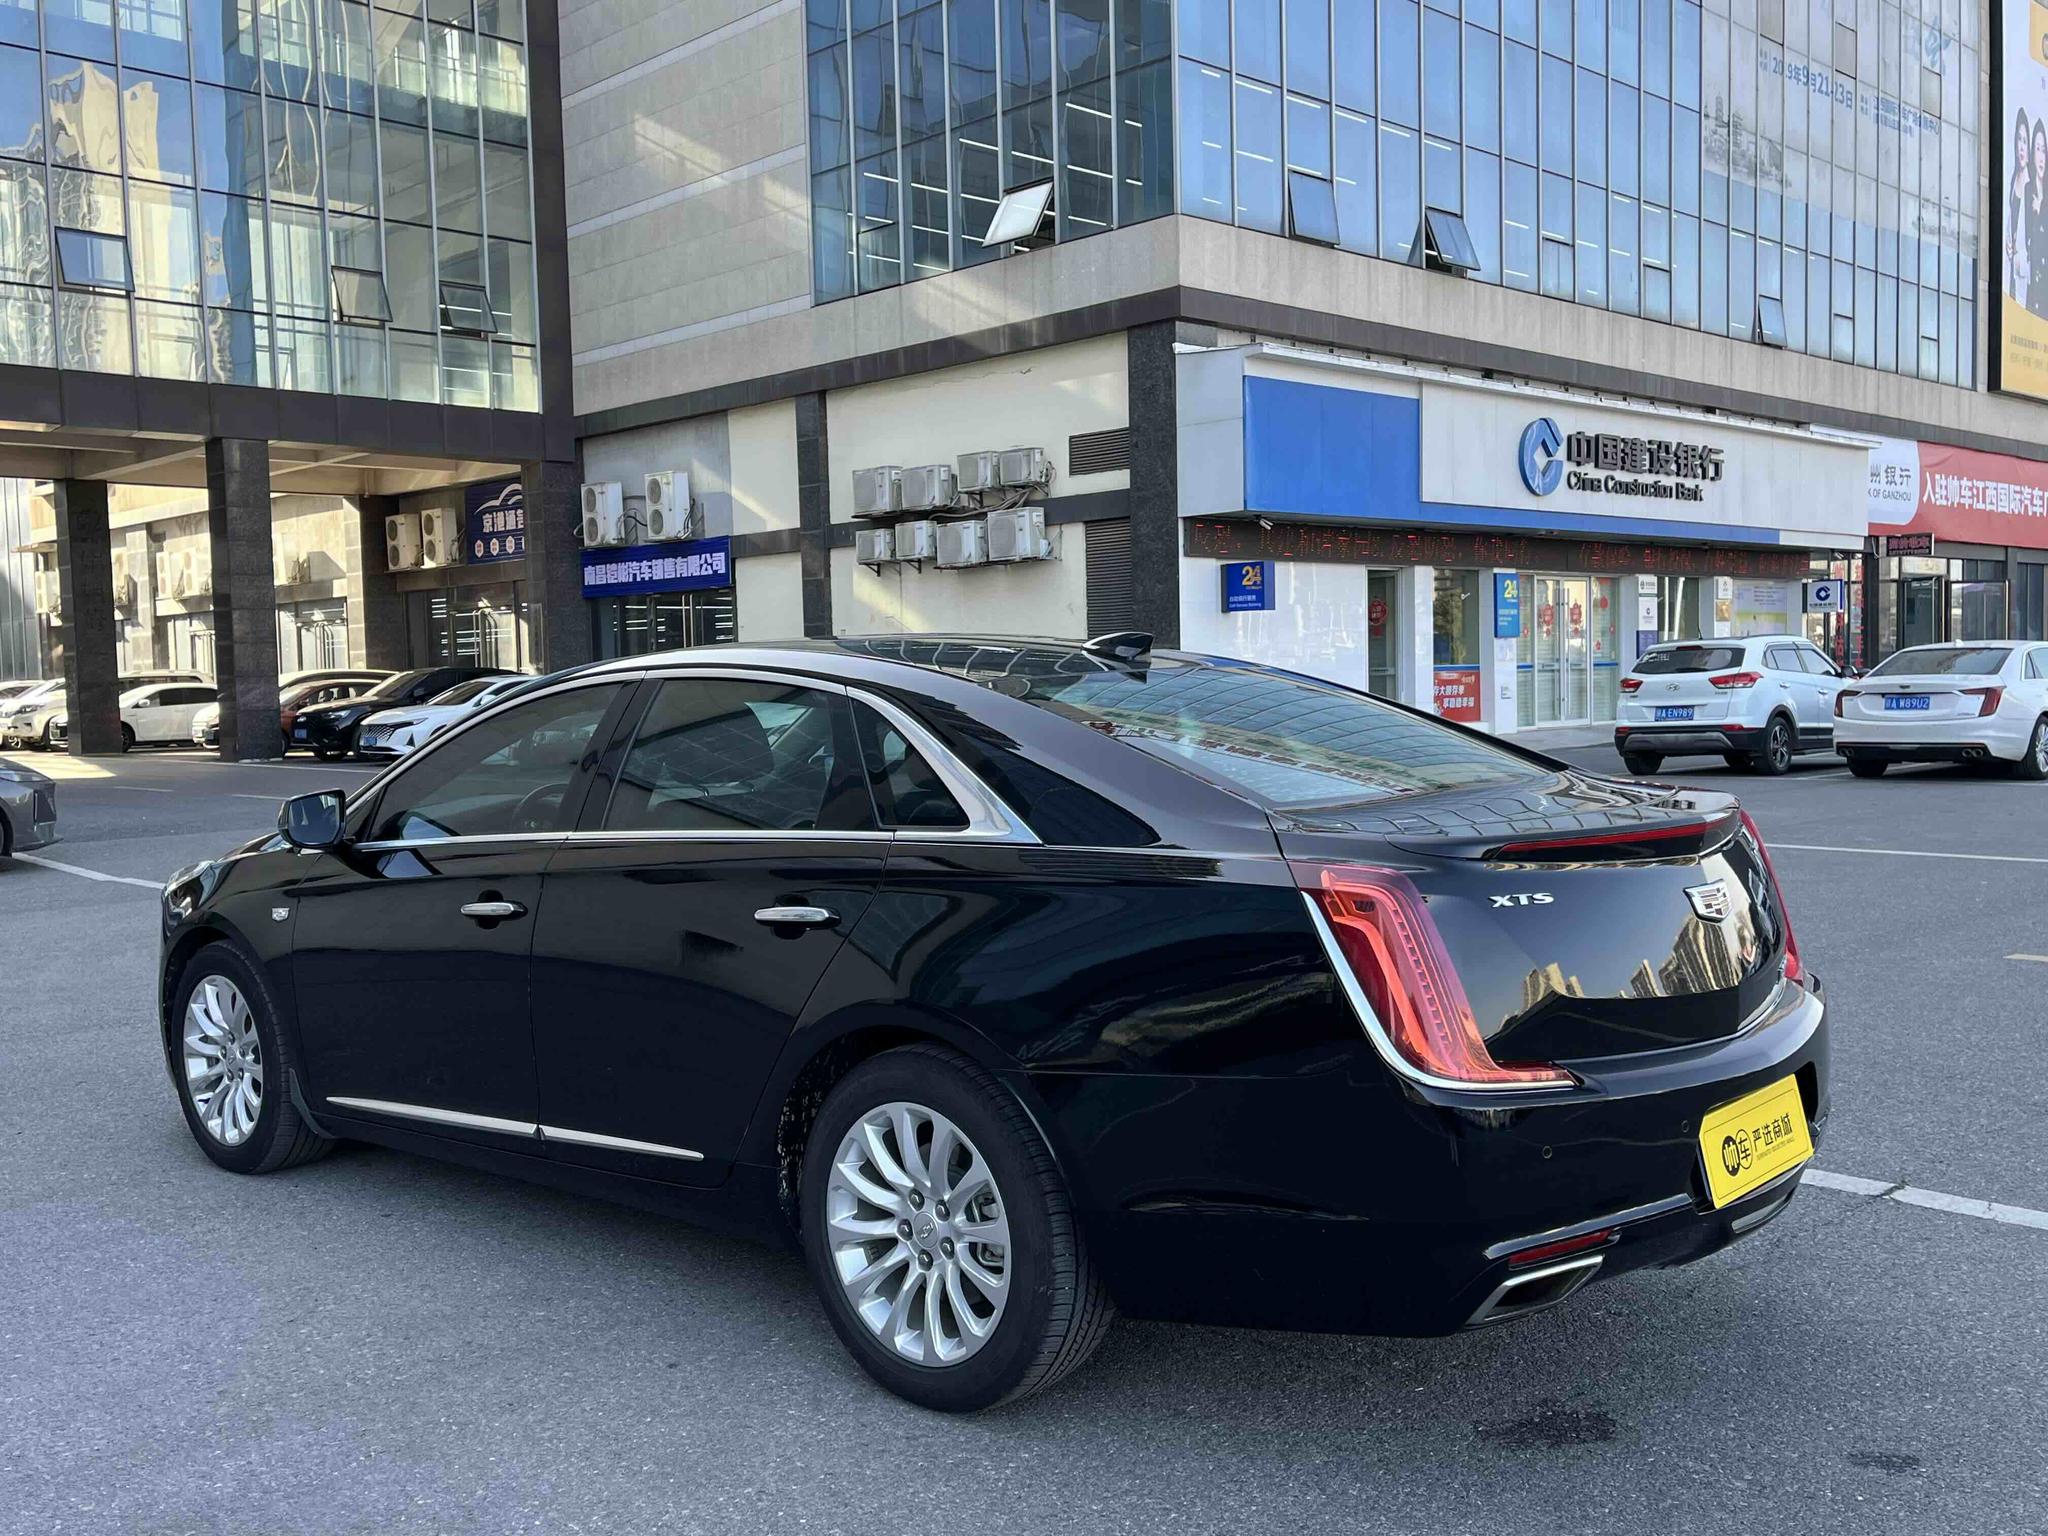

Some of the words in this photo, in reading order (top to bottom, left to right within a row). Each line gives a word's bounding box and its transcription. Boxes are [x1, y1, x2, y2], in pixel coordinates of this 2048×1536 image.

[1567, 431, 1725, 481] 中国建设银行
[1567, 470, 1602, 493] China
[1603, 475, 1673, 499] Construction
[1675, 482, 1704, 501] Bank
[1882, 489, 1912, 502] GANZHOU
[1242, 565, 1262, 586] 24
[1488, 892, 1555, 908] XTS
[1752, 1112, 1794, 1153] 严选商城
